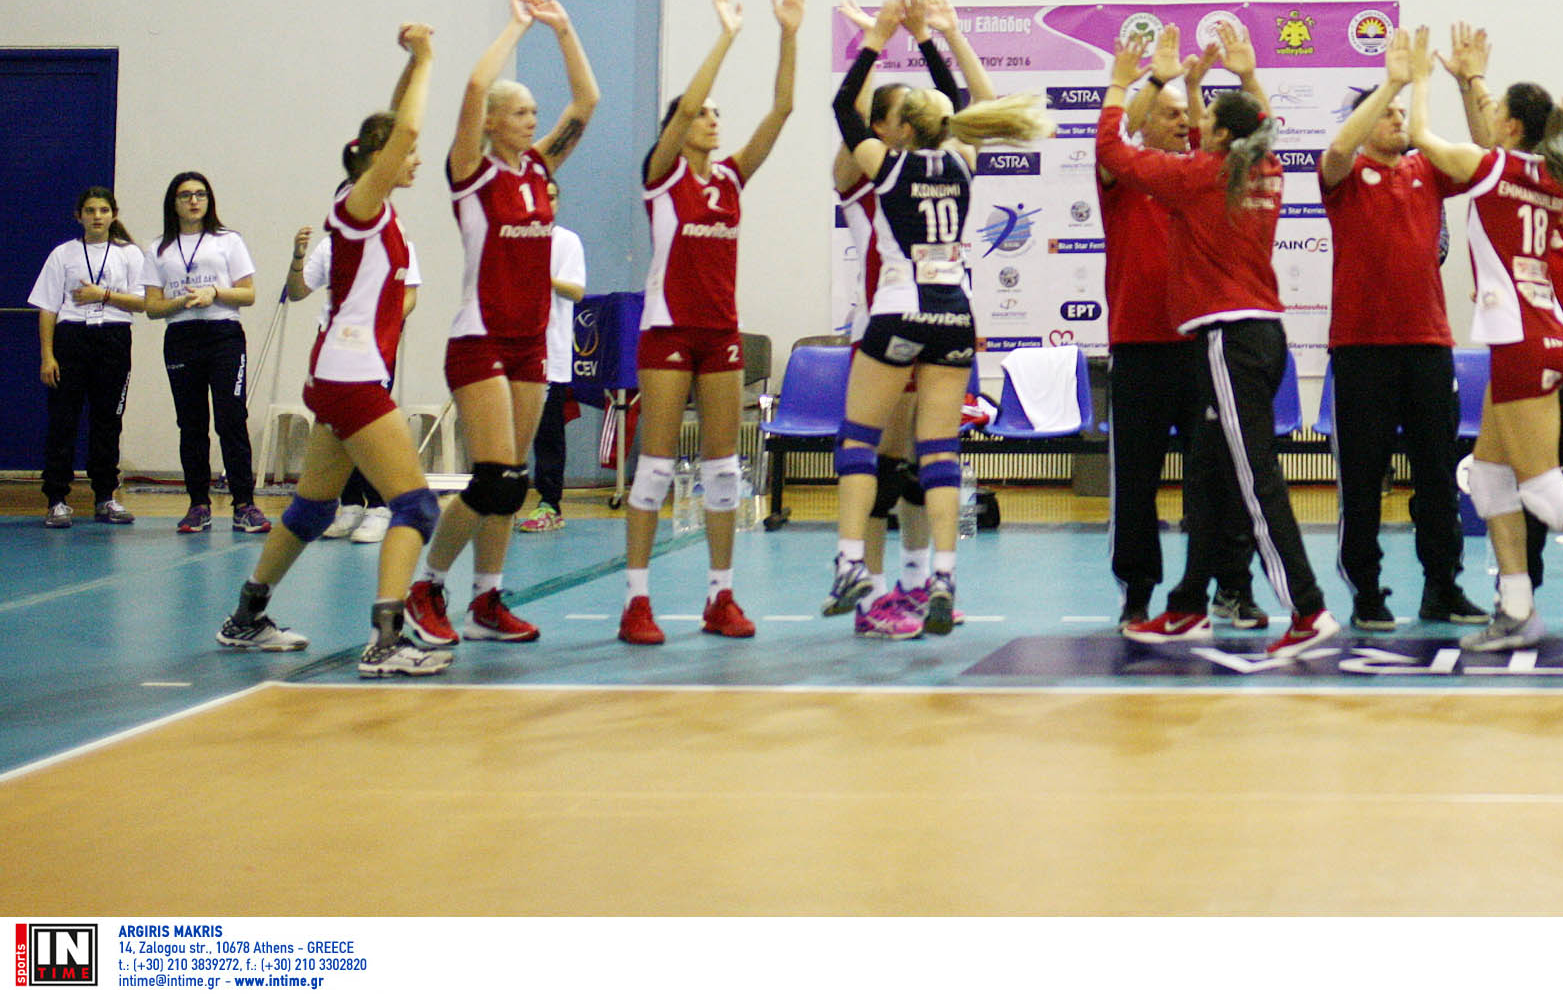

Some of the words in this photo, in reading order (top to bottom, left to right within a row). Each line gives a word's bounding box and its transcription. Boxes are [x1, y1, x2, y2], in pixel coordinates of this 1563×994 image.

[1007, 57, 1031, 66] 2016
[1060, 90, 1101, 102] ASTRA
[989, 156, 1030, 168] ASTRA
[519, 183, 536, 212] 1
[703, 186, 724, 212] 2
[918, 198, 959, 243] 10
[1518, 204, 1549, 257] 18
[1067, 304, 1096, 318] ΕΡΤ
[1003, 340, 1018, 348] Star
[1019, 340, 1041, 348] Ferries
[727, 344, 740, 362] 2
[574, 360, 599, 377] CEV
